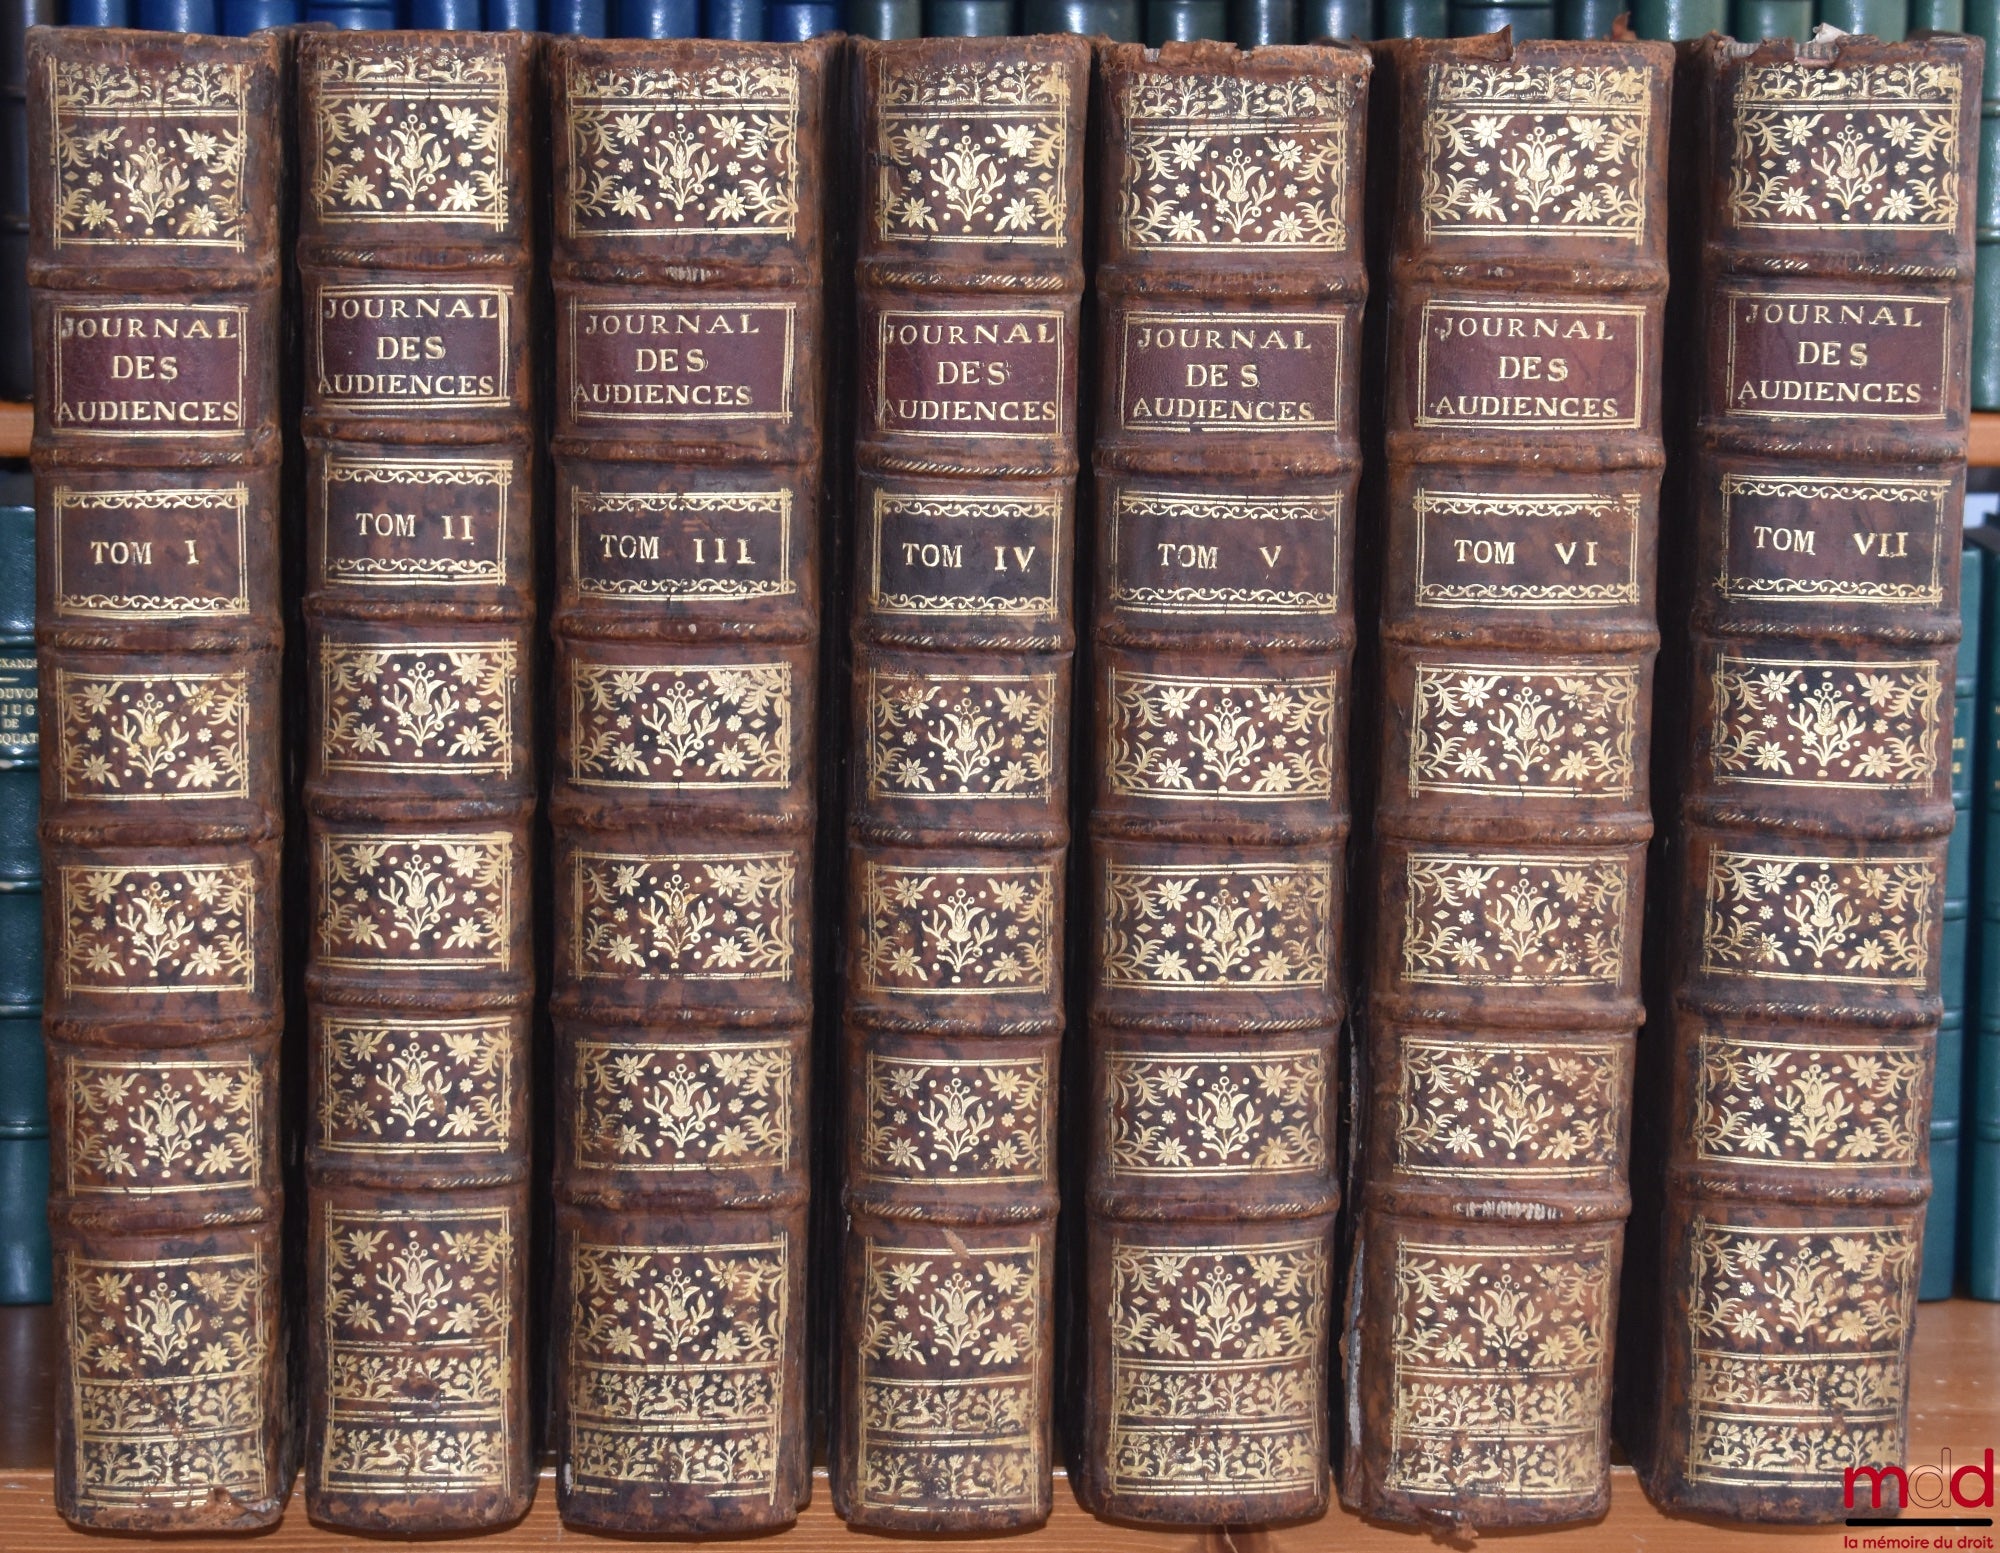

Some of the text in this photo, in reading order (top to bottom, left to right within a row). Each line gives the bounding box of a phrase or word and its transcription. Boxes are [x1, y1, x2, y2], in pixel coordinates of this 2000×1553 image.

[323, 299, 498, 319] JOURNAL
[1746, 304, 1922, 327] JOURNAL
[60, 317, 237, 340] JOURNAL
[586, 314, 759, 335] JOURNAL
[884, 325, 1055, 345] JOURNAL
[1437, 317, 1614, 340] JOURNAL
[377, 336, 445, 361] DES
[1138, 328, 1311, 351] JOURNAL
[636, 349, 708, 374] DES
[1797, 341, 1868, 367] DES
[111, 355, 178, 381] DES
[937, 360, 1009, 386] DES
[1184, 364, 1260, 388] DES
[1499, 356, 1569, 382] DES
[319, 374, 495, 396] AUDIENCES
[573, 383, 752, 406] AUDIENCES
[1738, 380, 1921, 403] AUDIENCES
[58, 401, 240, 423] AUDIENCES
[880, 400, 1056, 422] AUDIENCES
[1133, 398, 1315, 422] AUDIENCES
[1436, 396, 1618, 419] AUDIENCES
[356, 513, 474, 541] TOM II
[91, 539, 199, 565] TOM I
[600, 534, 756, 564] TOM III
[1455, 540, 1598, 566] TOM VI
[1754, 526, 1908, 557] TOM VII
[903, 542, 1035, 573] TOM IV
[1158, 543, 1282, 569] TOM V
